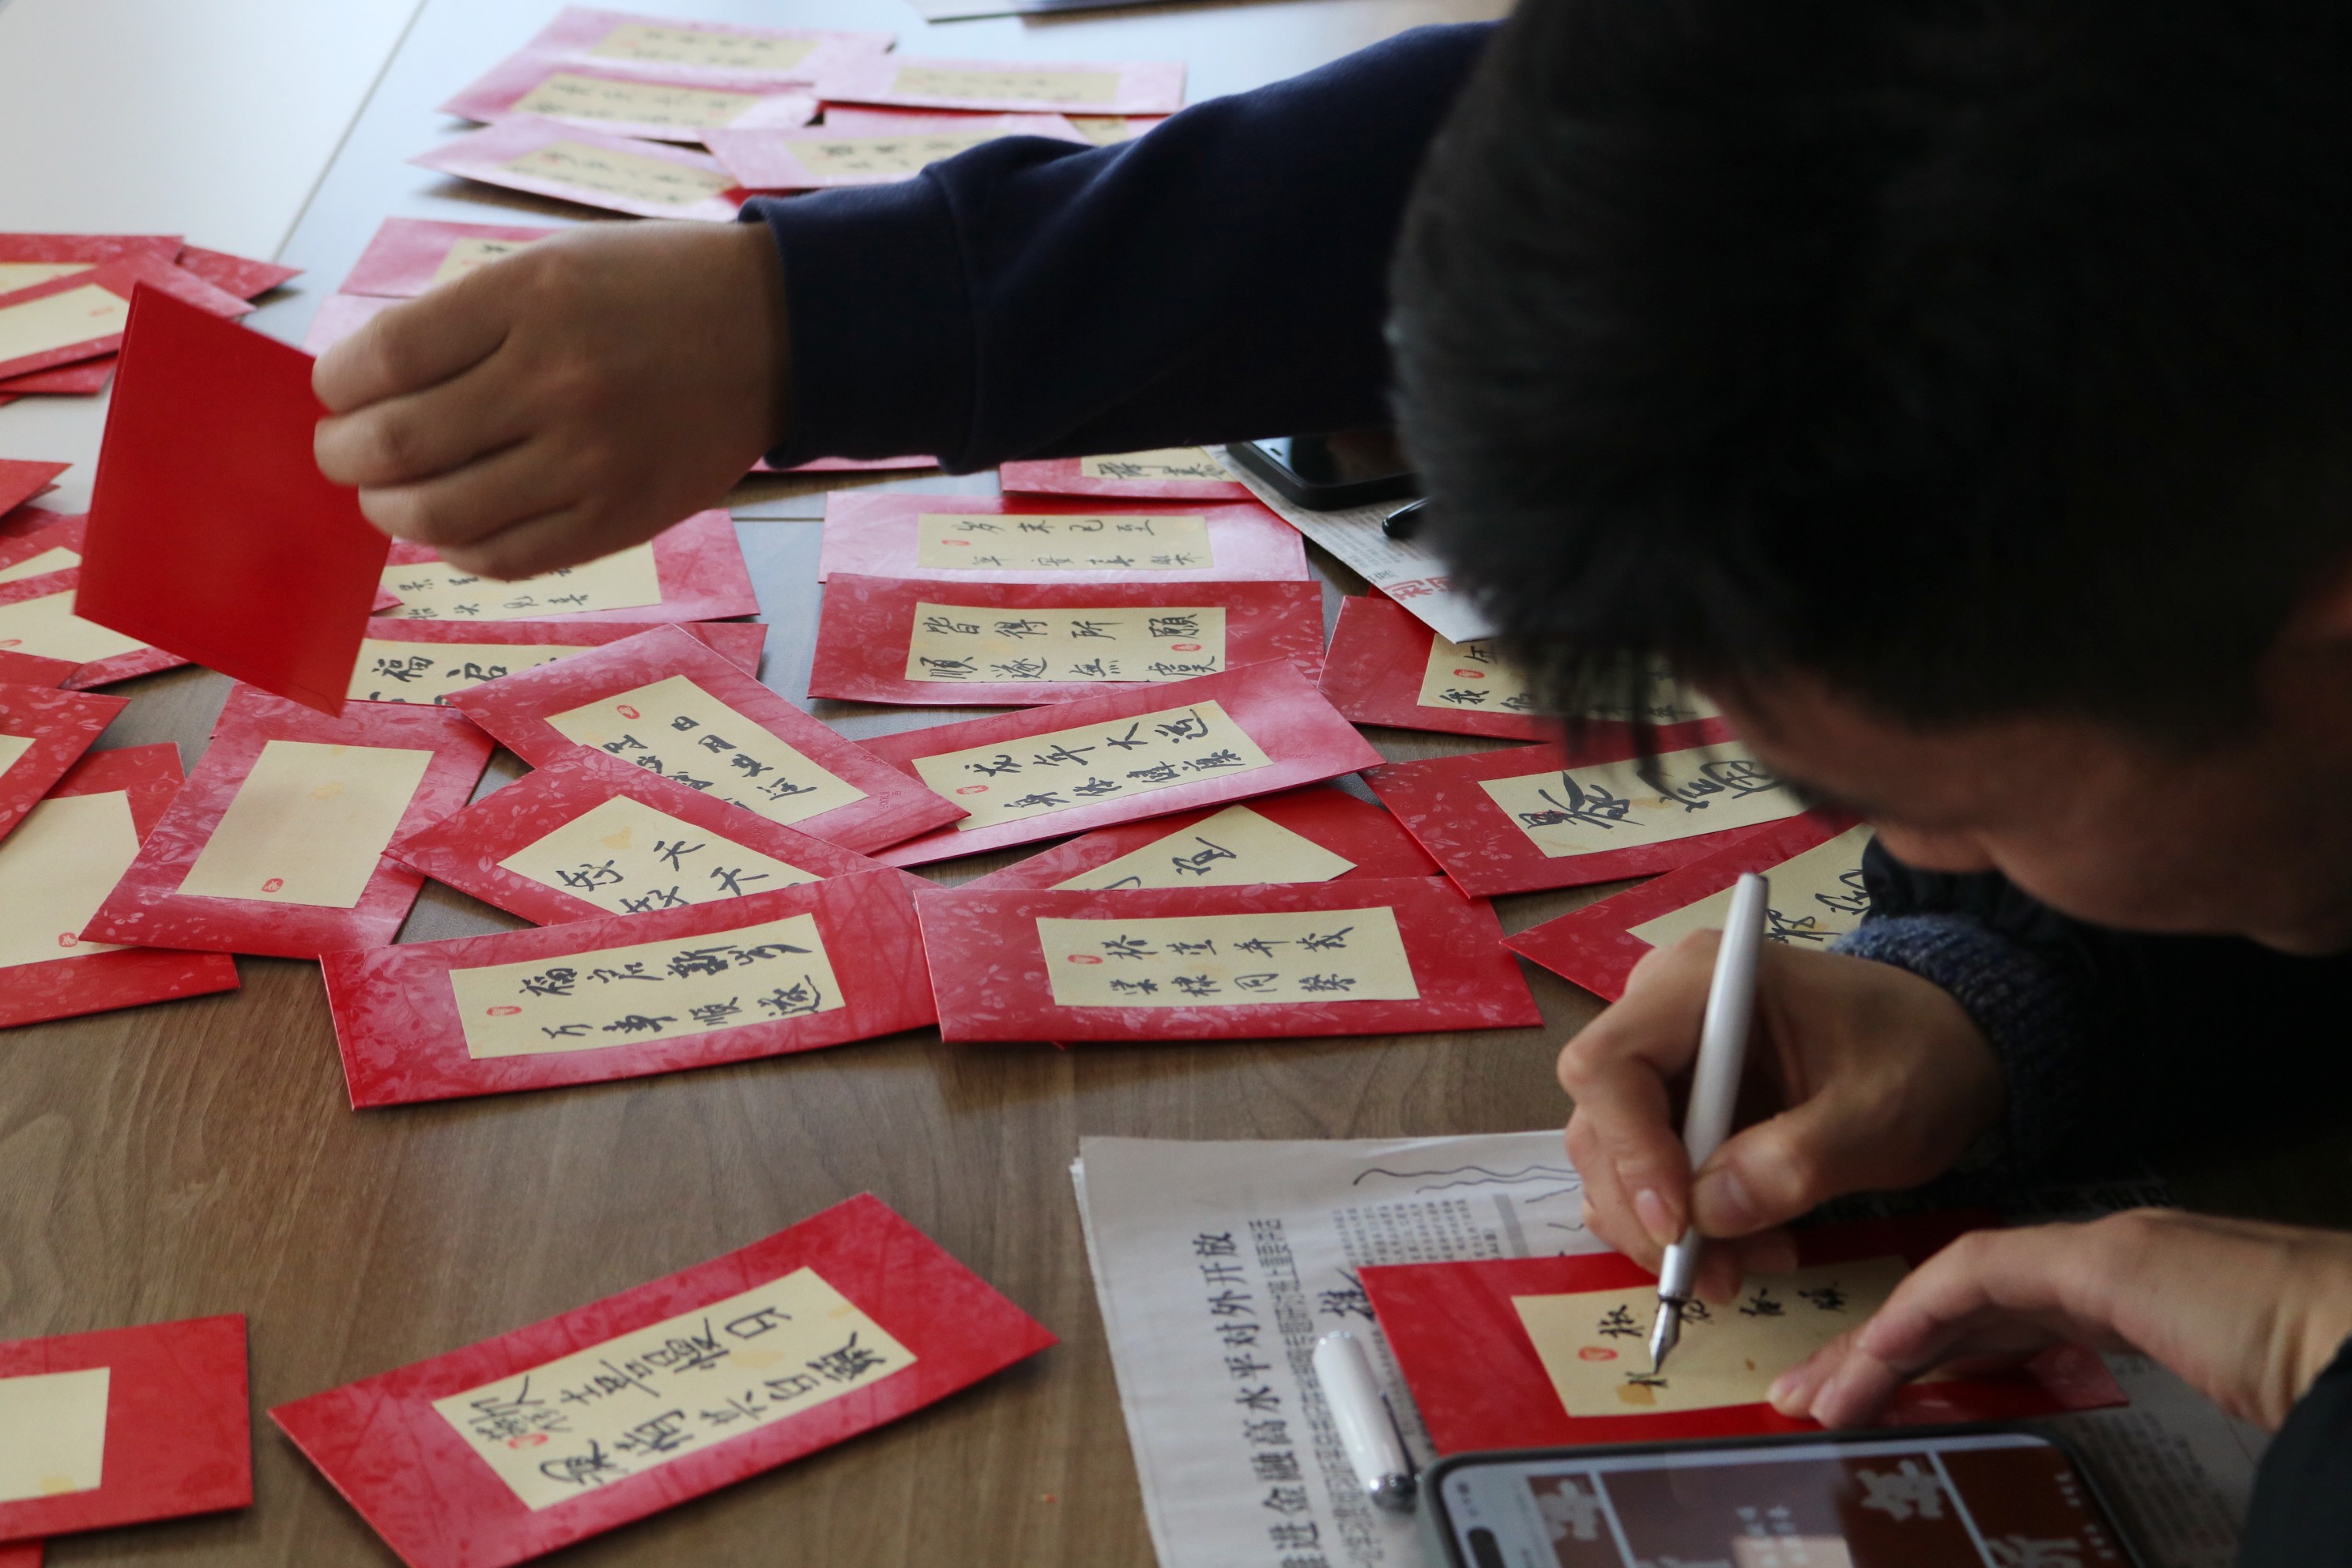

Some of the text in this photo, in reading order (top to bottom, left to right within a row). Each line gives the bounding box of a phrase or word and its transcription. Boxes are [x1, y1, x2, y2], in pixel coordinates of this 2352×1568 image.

[963, 707, 1208, 778] 龙年大运
[1002, 748, 1246, 808] 身体健康
[518, 943, 813, 997] 福启新岁
